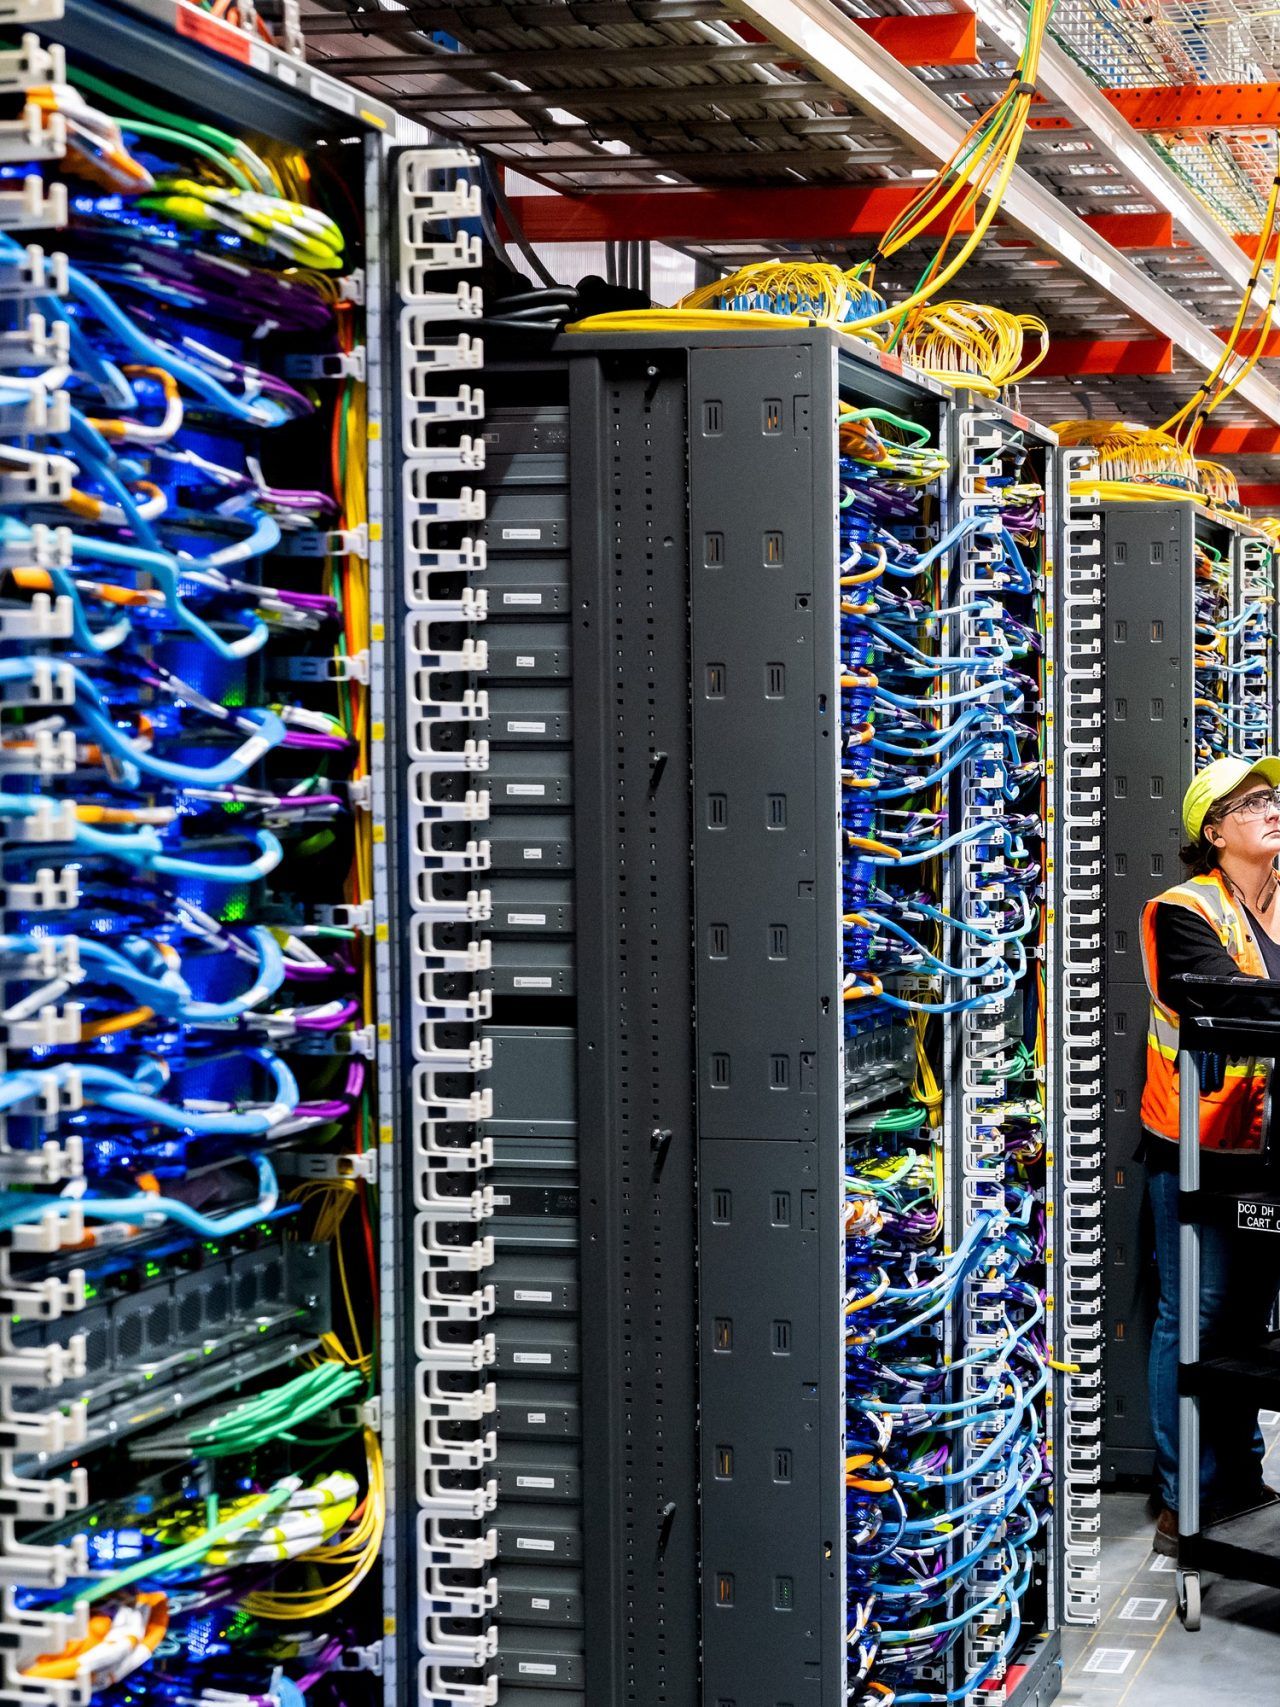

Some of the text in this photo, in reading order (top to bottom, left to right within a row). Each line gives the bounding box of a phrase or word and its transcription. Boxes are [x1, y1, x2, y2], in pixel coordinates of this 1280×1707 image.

[1238, 1203, 1257, 1215] DCO
[1261, 1205, 1274, 1217] DH
[1246, 1216, 1271, 1229] CART
